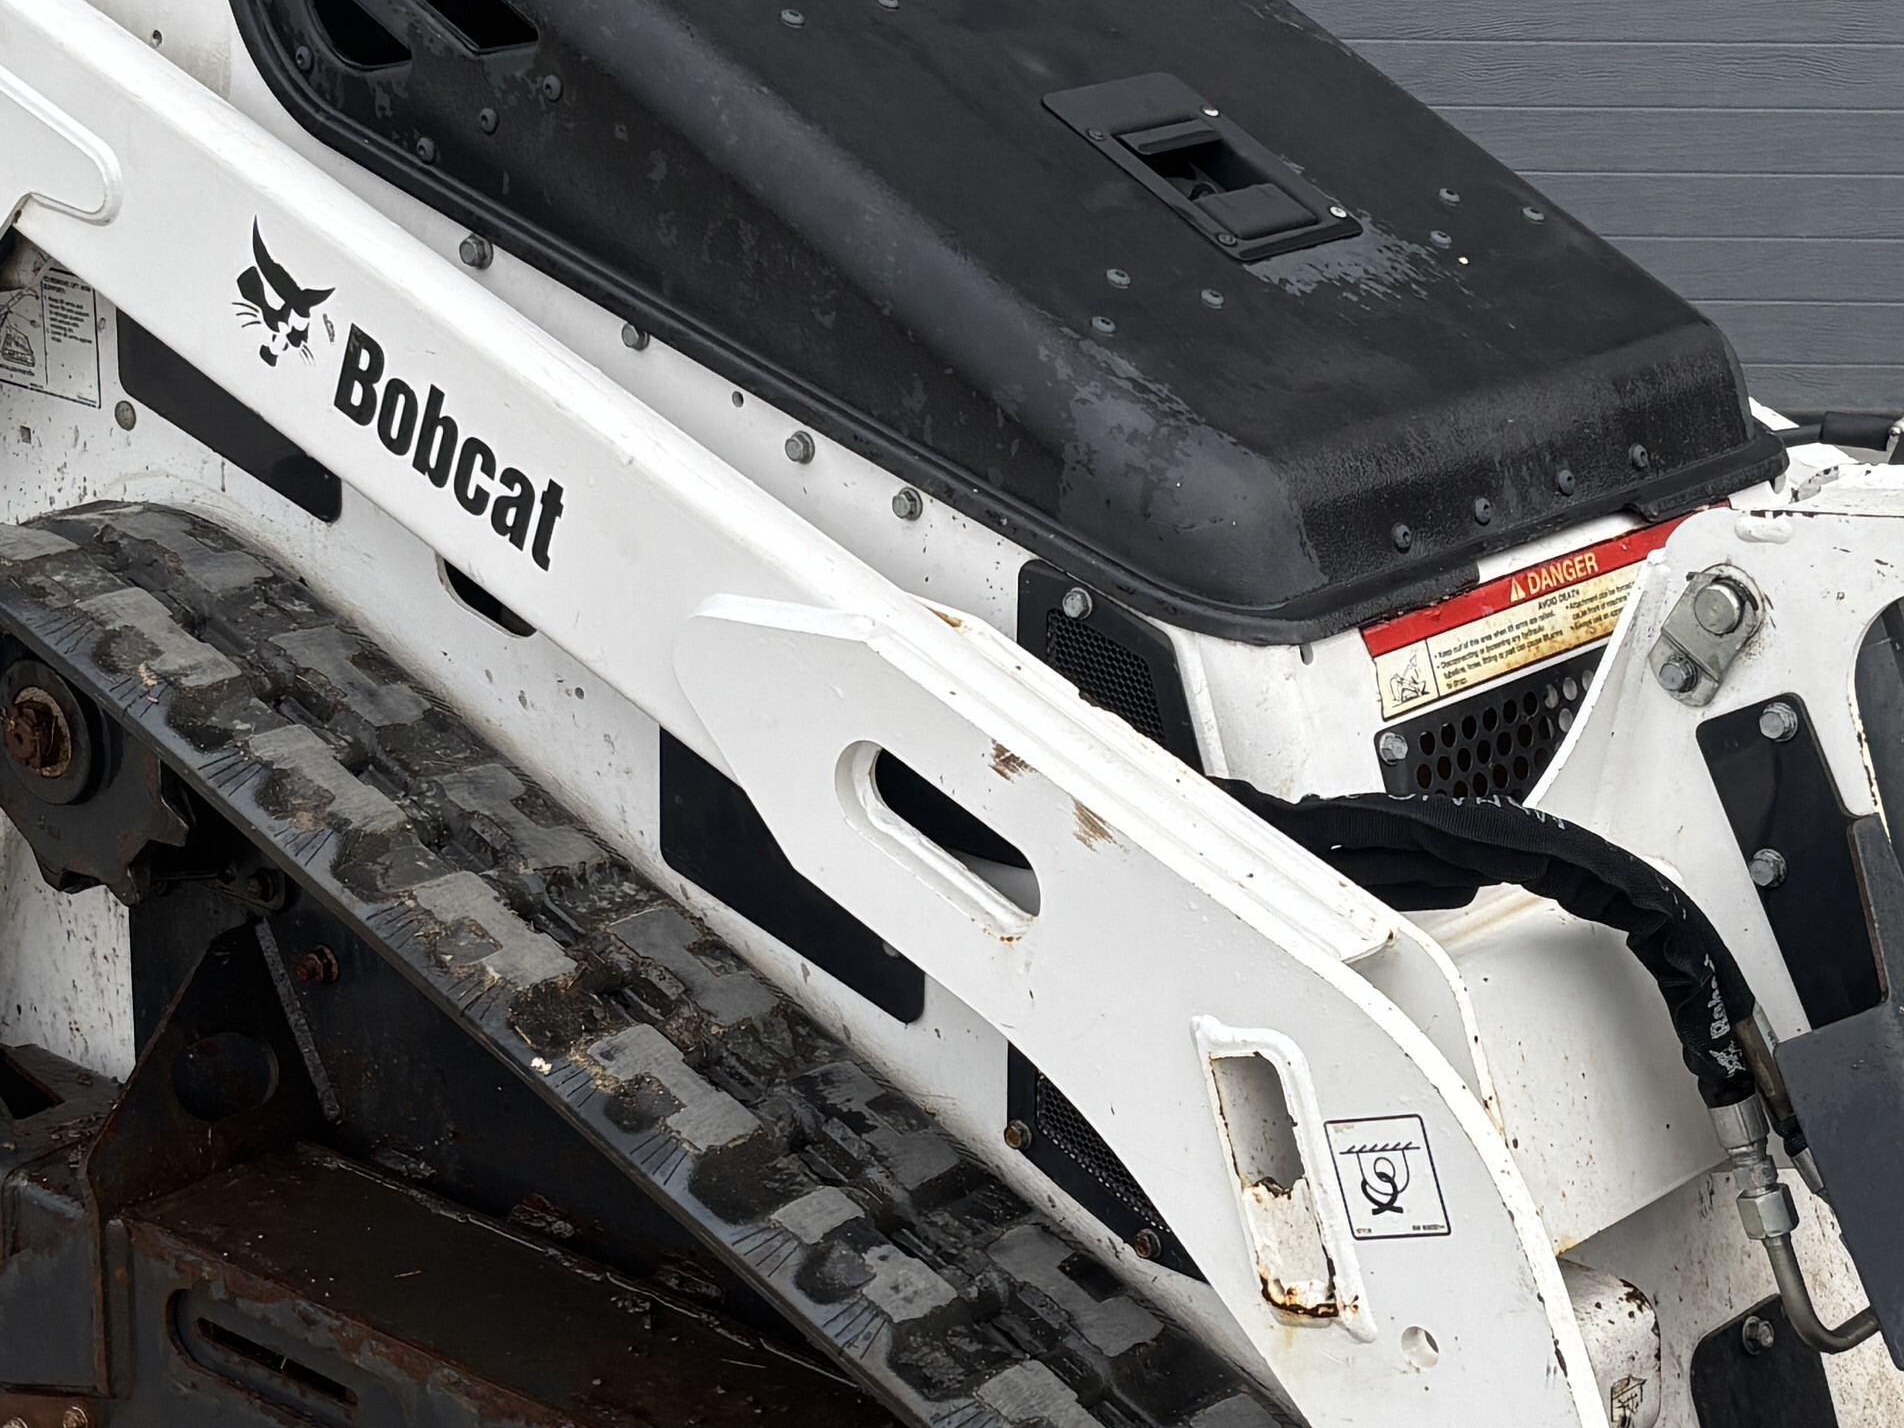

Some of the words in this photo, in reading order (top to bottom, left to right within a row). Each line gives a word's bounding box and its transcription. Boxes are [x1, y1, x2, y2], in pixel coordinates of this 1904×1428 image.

[334, 323, 564, 572] Bobcat
[1527, 552, 1599, 595] DANGER
[1538, 595, 1557, 610] AVOID
